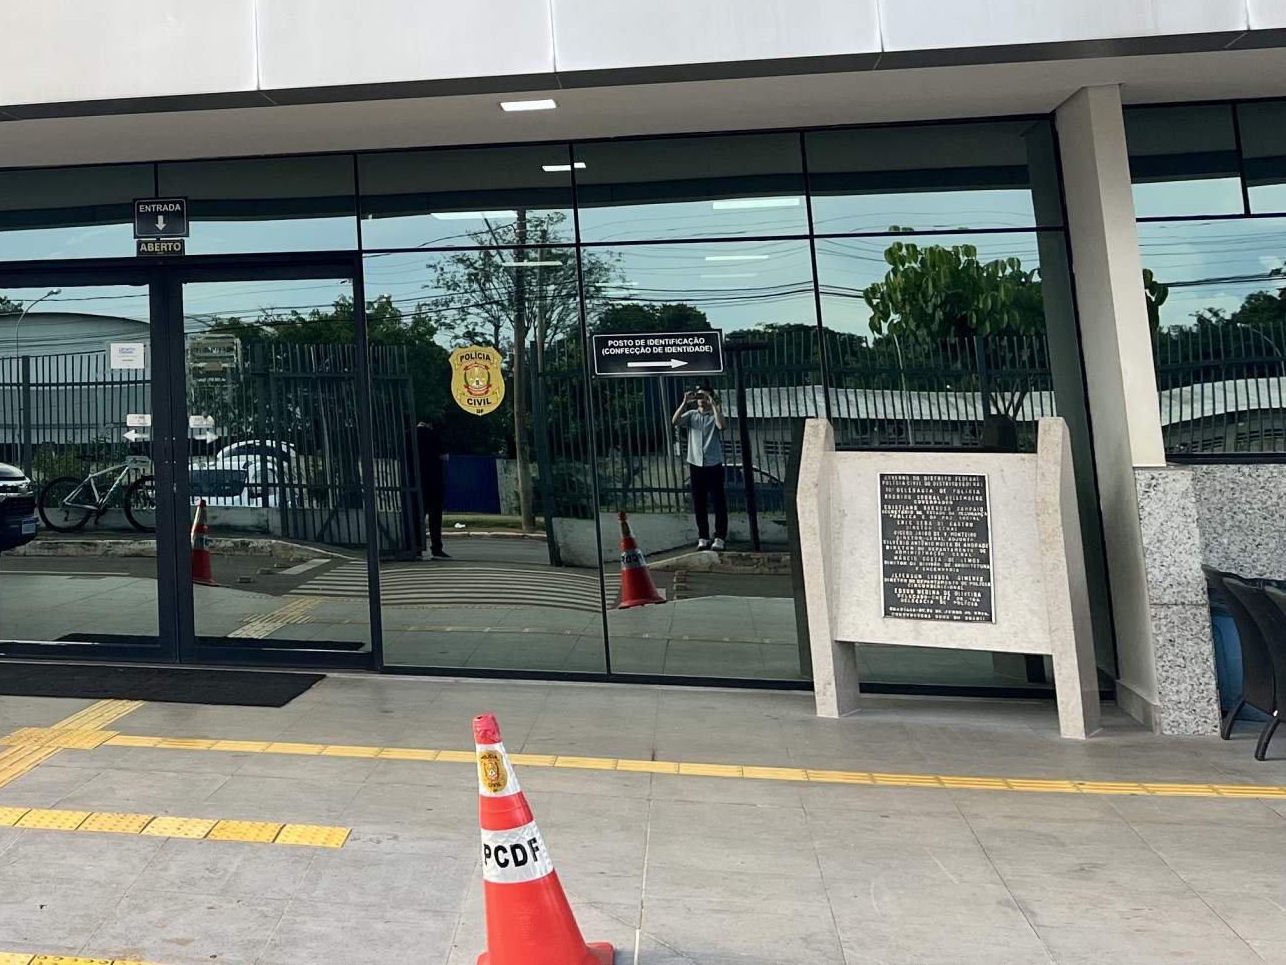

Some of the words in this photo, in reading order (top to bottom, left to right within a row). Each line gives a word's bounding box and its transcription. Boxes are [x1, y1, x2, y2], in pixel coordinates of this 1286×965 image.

[139, 204, 181, 213] ENTRADA
[139, 242, 181, 252] ABERTO
[608, 339, 634, 347] POSTO
[647, 337, 706, 346] IDENTIFICAÇÃO
[601, 347, 652, 356] (CONFECÇÃO
[653, 346, 664, 354] DE
[665, 345, 714, 354] IDENTIDADE)
[460, 352, 491, 362] POLÍCIA
[466, 397, 492, 406] CIVIL
[483, 837, 540, 868] PCDF
